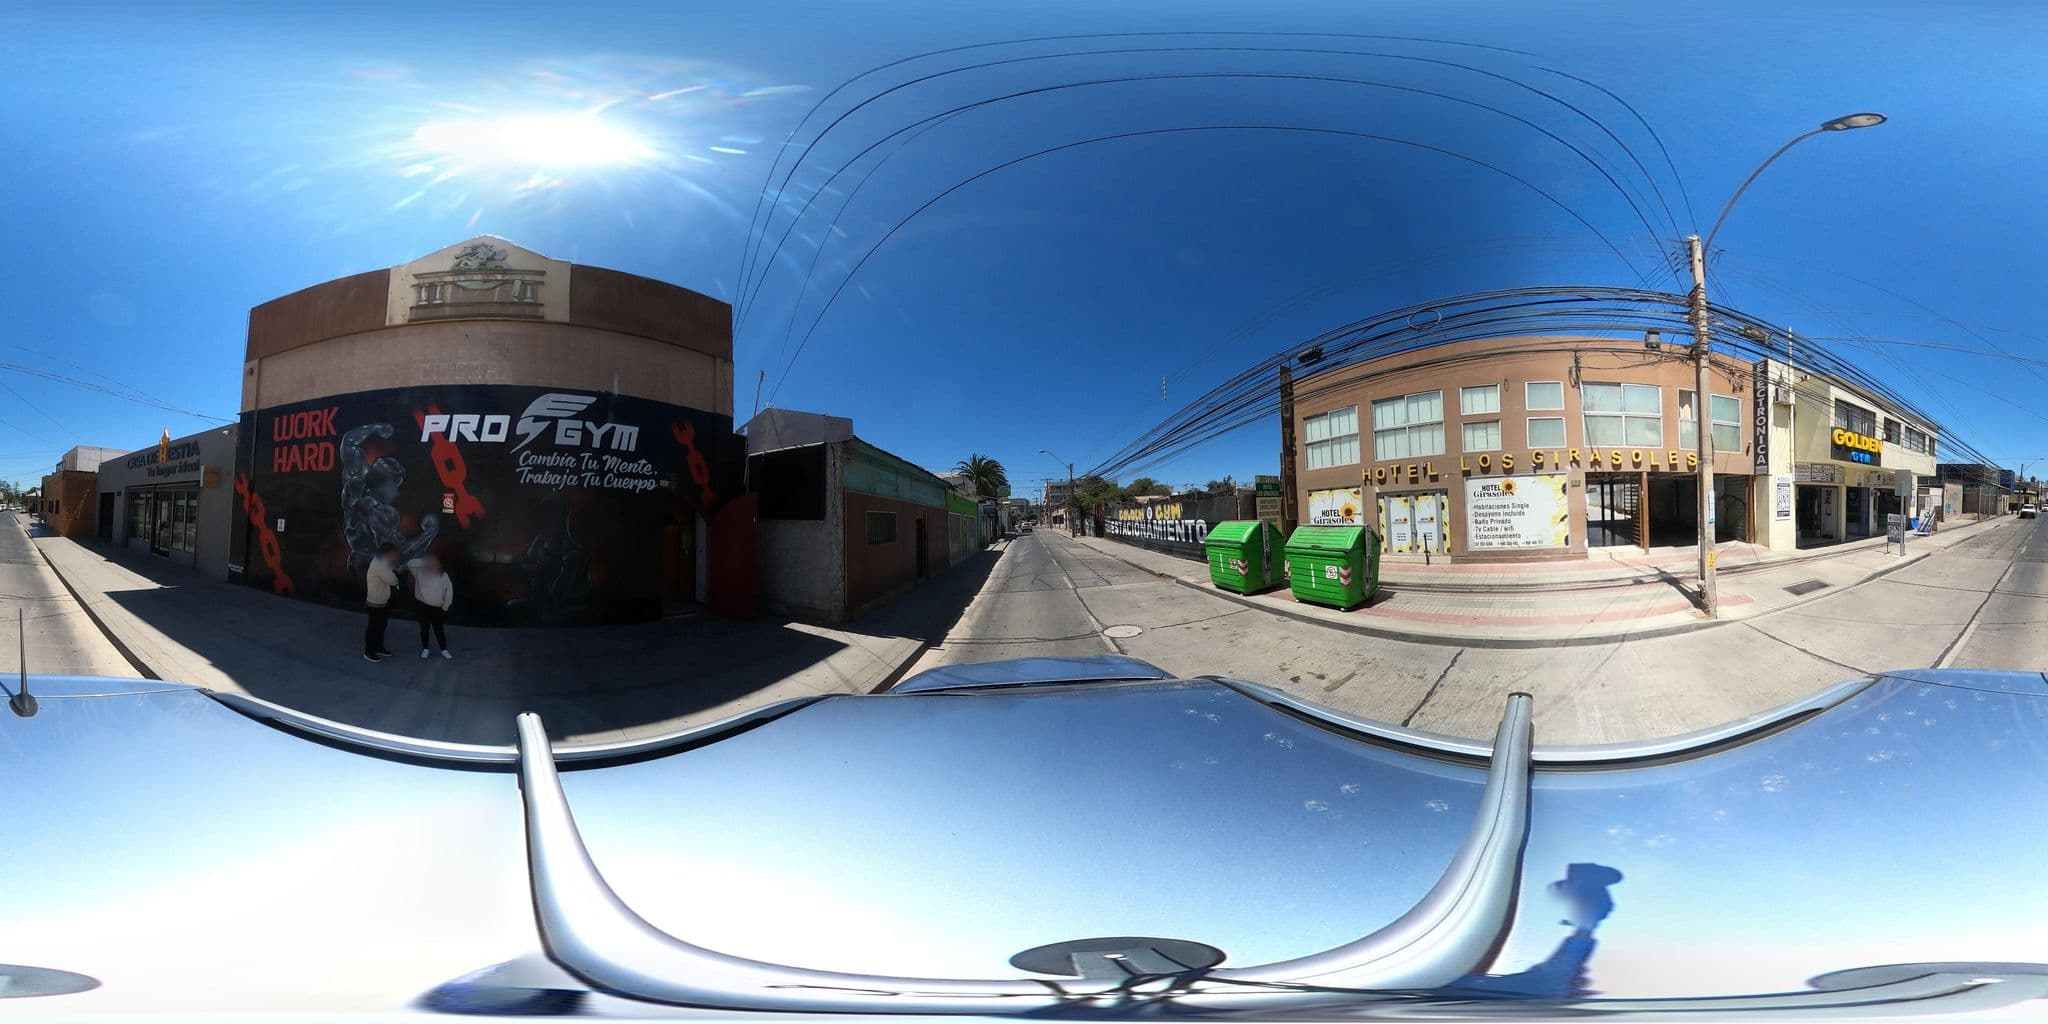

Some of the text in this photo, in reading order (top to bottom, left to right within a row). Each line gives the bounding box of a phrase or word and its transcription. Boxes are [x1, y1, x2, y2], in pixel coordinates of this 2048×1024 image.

[273, 406, 340, 442] WORK
[421, 414, 640, 453] PRO GYM
[1833, 428, 1883, 453] GOLDEN
[273, 441, 336, 473] HARD
[519, 450, 577, 470] Cambia
[580, 452, 600, 470] Tu
[1362, 447, 1698, 480] HOTEL LOS GIRASOLES
[1851, 451, 1871, 464] GYM
[516, 467, 659, 494] Trabaja Tu Cuerpo
[1473, 490, 1515, 498] Girasoles
[1313, 516, 1354, 525] Girasoles
[1321, 509, 1341, 517] HOTEL
[1110, 518, 1207, 544] ESTACIONAMIENTO
